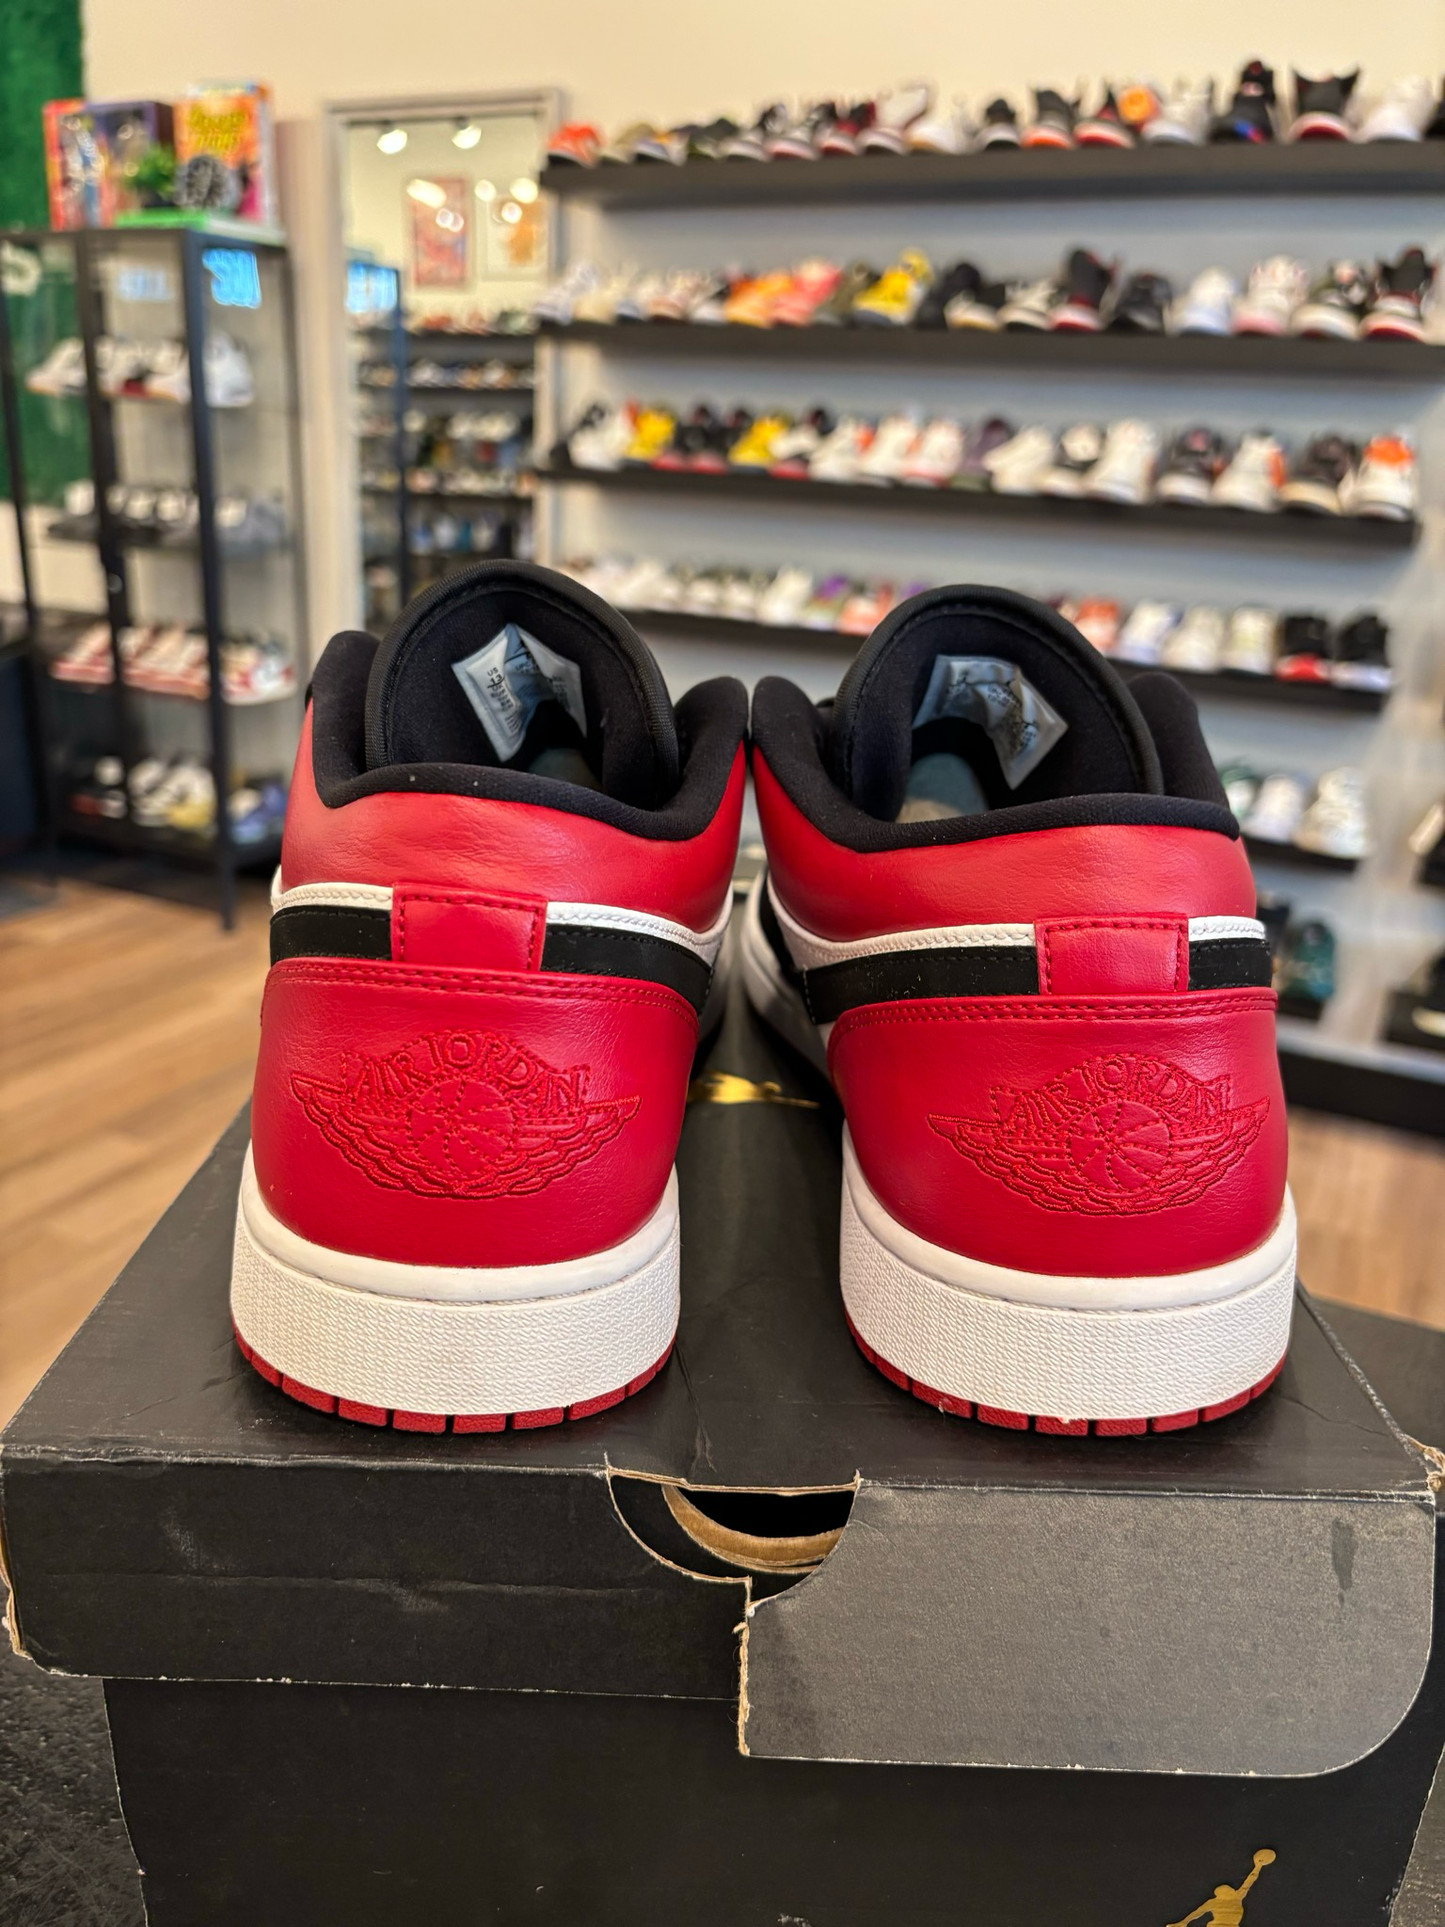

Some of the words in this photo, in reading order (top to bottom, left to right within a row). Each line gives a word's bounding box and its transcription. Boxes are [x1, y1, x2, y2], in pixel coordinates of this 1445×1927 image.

[353, 1052, 428, 1101] AIR
[426, 1034, 581, 1112] JORDAN
[1003, 1083, 1088, 1130] AIR
[1079, 1057, 1225, 1126] JORDAN
